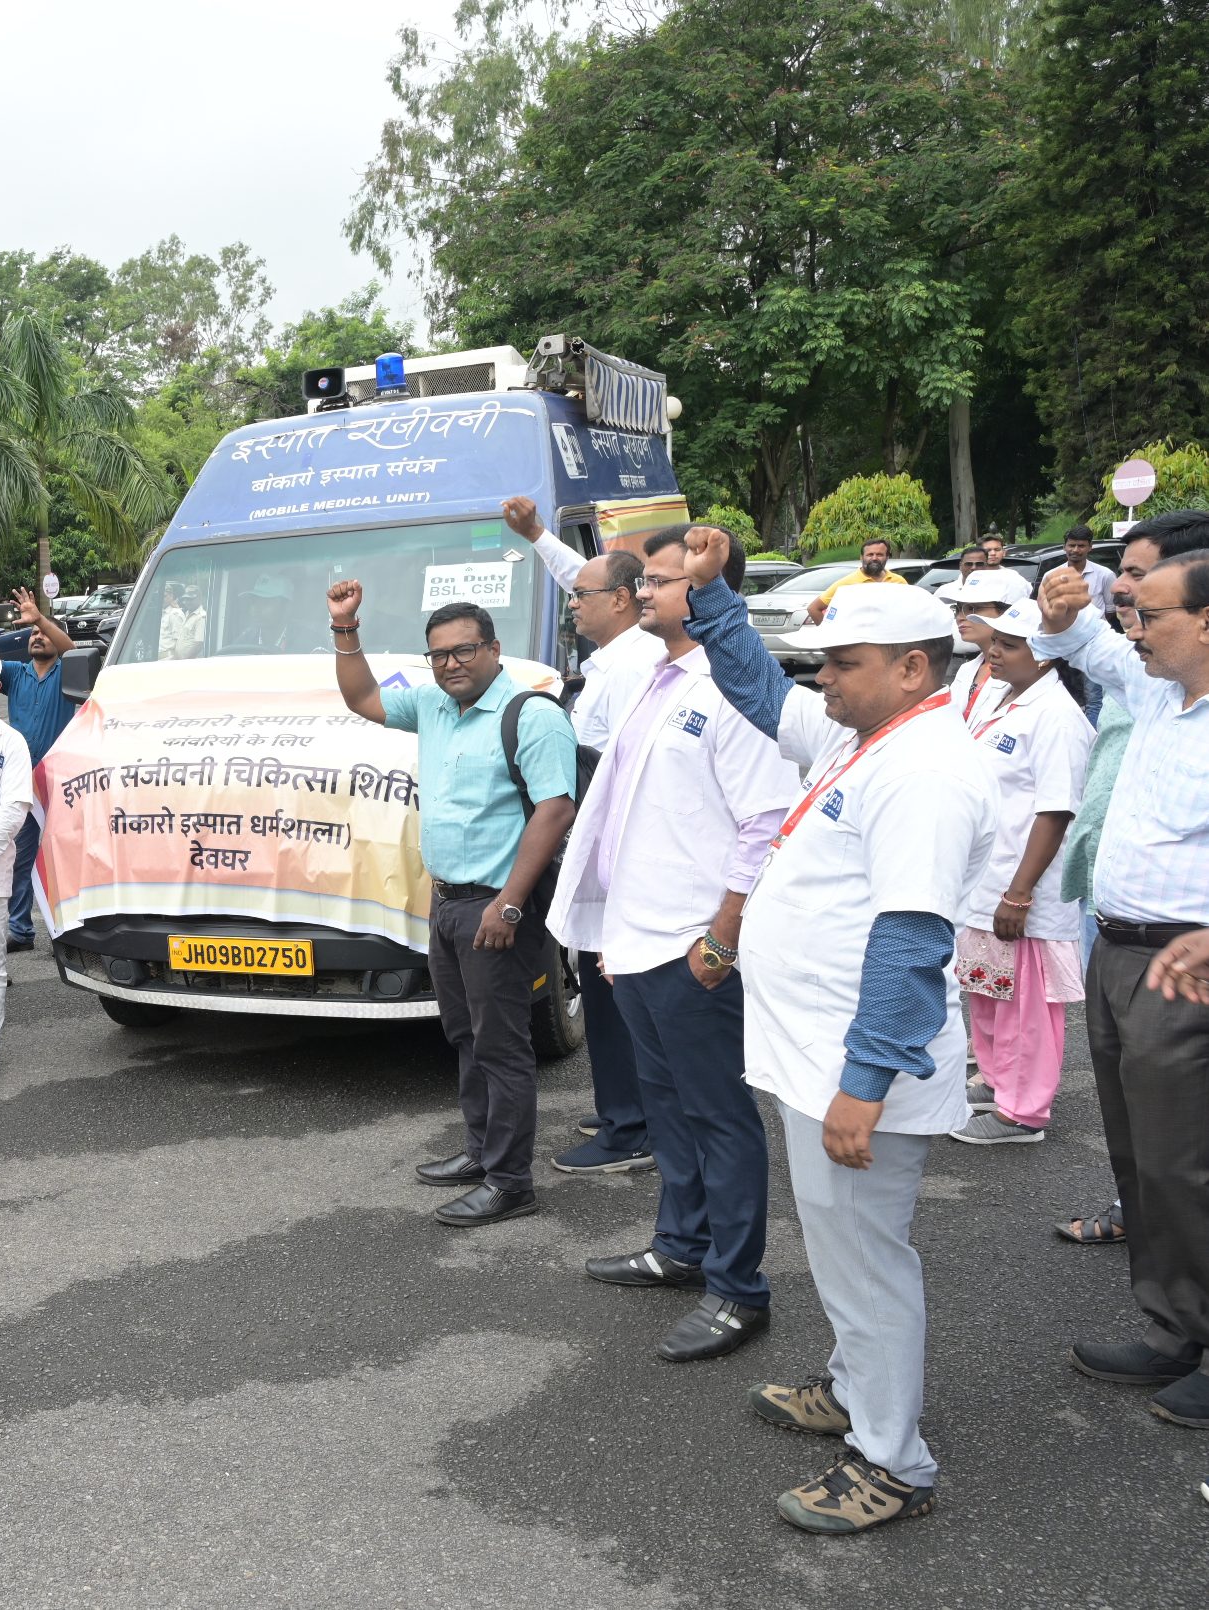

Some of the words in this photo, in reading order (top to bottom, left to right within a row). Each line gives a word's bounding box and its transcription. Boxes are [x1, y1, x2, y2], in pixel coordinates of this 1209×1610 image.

[231, 424, 339, 463] इस्पात
[346, 401, 536, 449] संजीवनी
[252, 467, 314, 493] बोकारो
[320, 463, 380, 486] इस्पात
[386, 456, 447, 477] संयंत्र
[249, 503, 310, 520] (MOBILE
[313, 495, 379, 511] MEDICAL
[386, 491, 431, 504] UNIT)
[429, 585, 466, 597] BSL,
[471, 583, 506, 594] CSR
[430, 576, 455, 584] On
[463, 573, 508, 583] Duty
[238, 715, 321, 727] इस्पात
[326, 713, 381, 727] संय
[688, 713, 705, 729] CSR
[246, 733, 269, 747] के
[272, 733, 315, 747] लिए
[62, 766, 115, 808] इस्पात
[120, 757, 217, 788] संजीवनी
[224, 757, 341, 794] चिकित्सा
[180, 813, 243, 837] इस्पात
[250, 809, 352, 850] धर्मशाला)
[189, 840, 252, 871] देवघर
[183, 943, 308, 969] JH09BD2750
